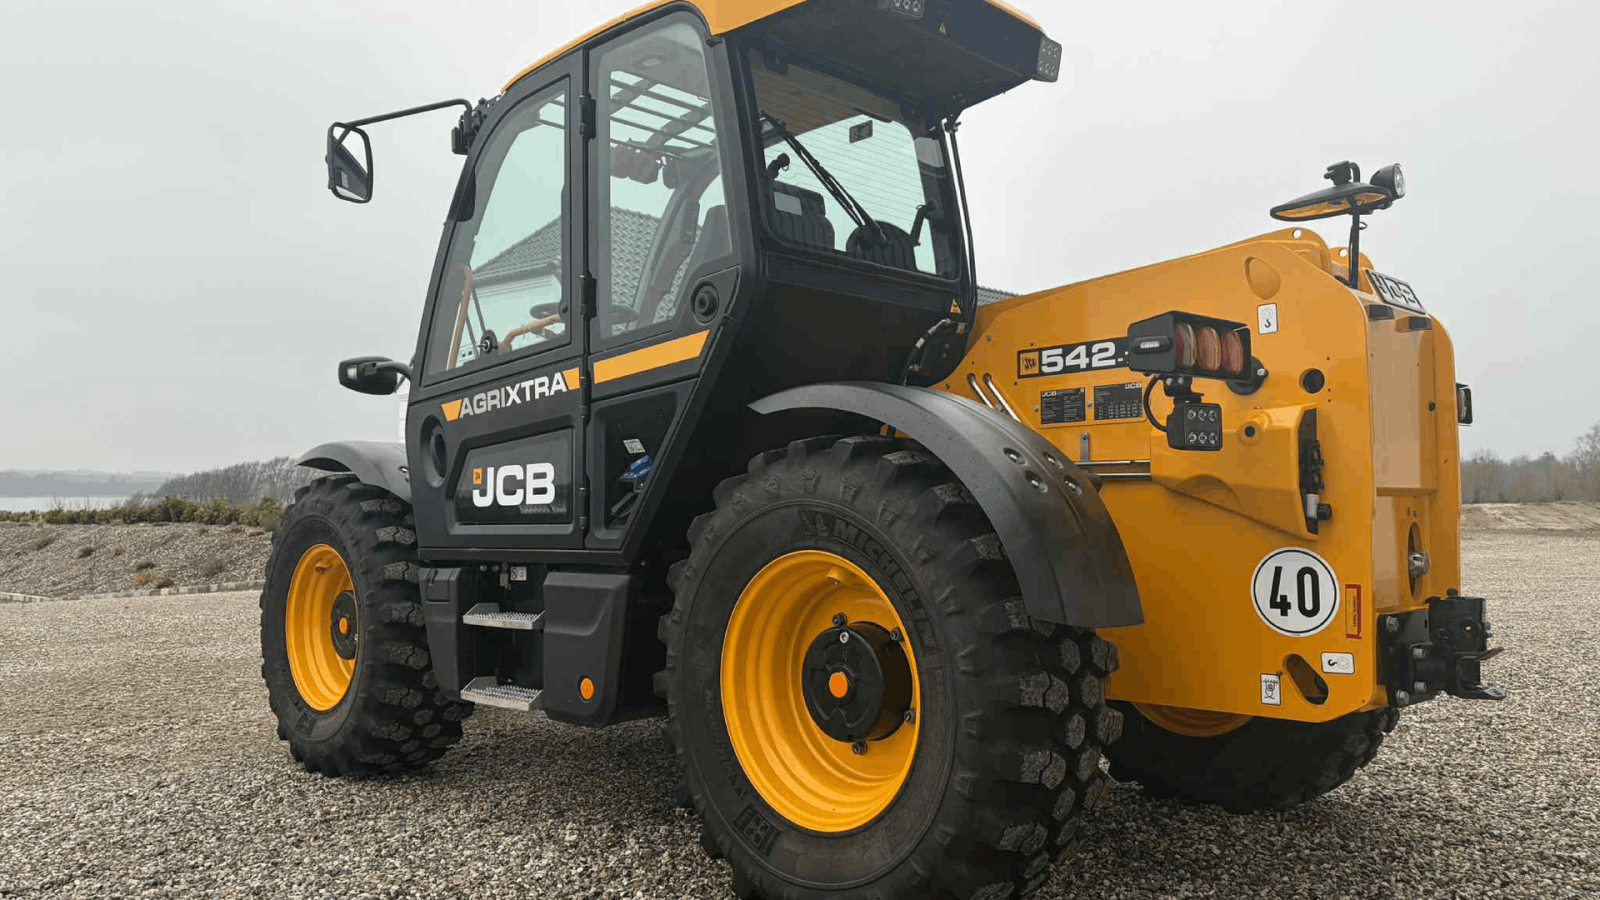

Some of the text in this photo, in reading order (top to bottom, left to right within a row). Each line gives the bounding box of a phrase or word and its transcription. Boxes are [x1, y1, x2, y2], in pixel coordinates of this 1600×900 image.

[459, 370, 567, 419] AGRIXTRA
[472, 462, 556, 508] JCB
[1269, 565, 1321, 618] 40
